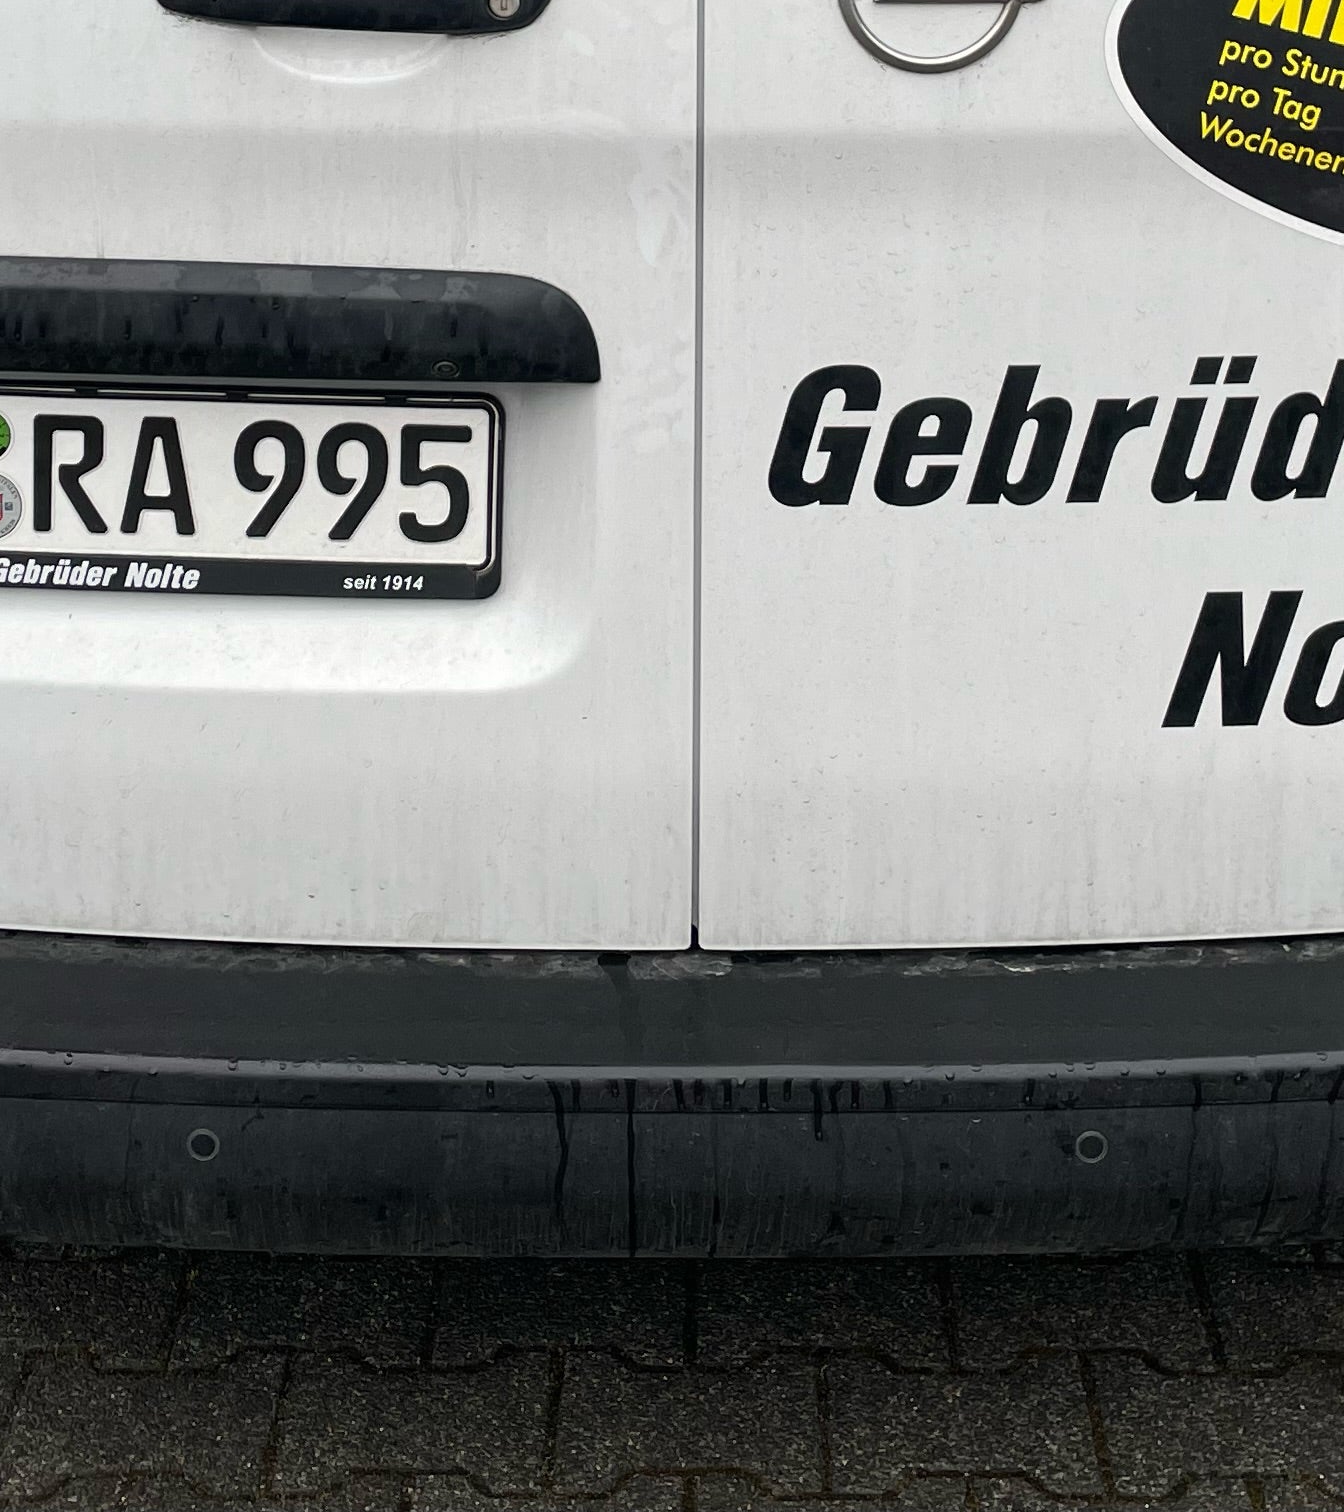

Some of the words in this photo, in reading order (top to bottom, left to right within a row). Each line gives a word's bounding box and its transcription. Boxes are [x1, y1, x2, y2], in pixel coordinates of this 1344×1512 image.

[1219, 40, 1272, 68] pro
[1207, 80, 1260, 108] pro
[1274, 88, 1321, 129] Tag
[34, 414, 195, 535] RA
[234, 420, 472, 543] 995
[123, 561, 200, 590] Nolte
[344, 575, 376, 589] seit
[383, 575, 423, 590] 1914
